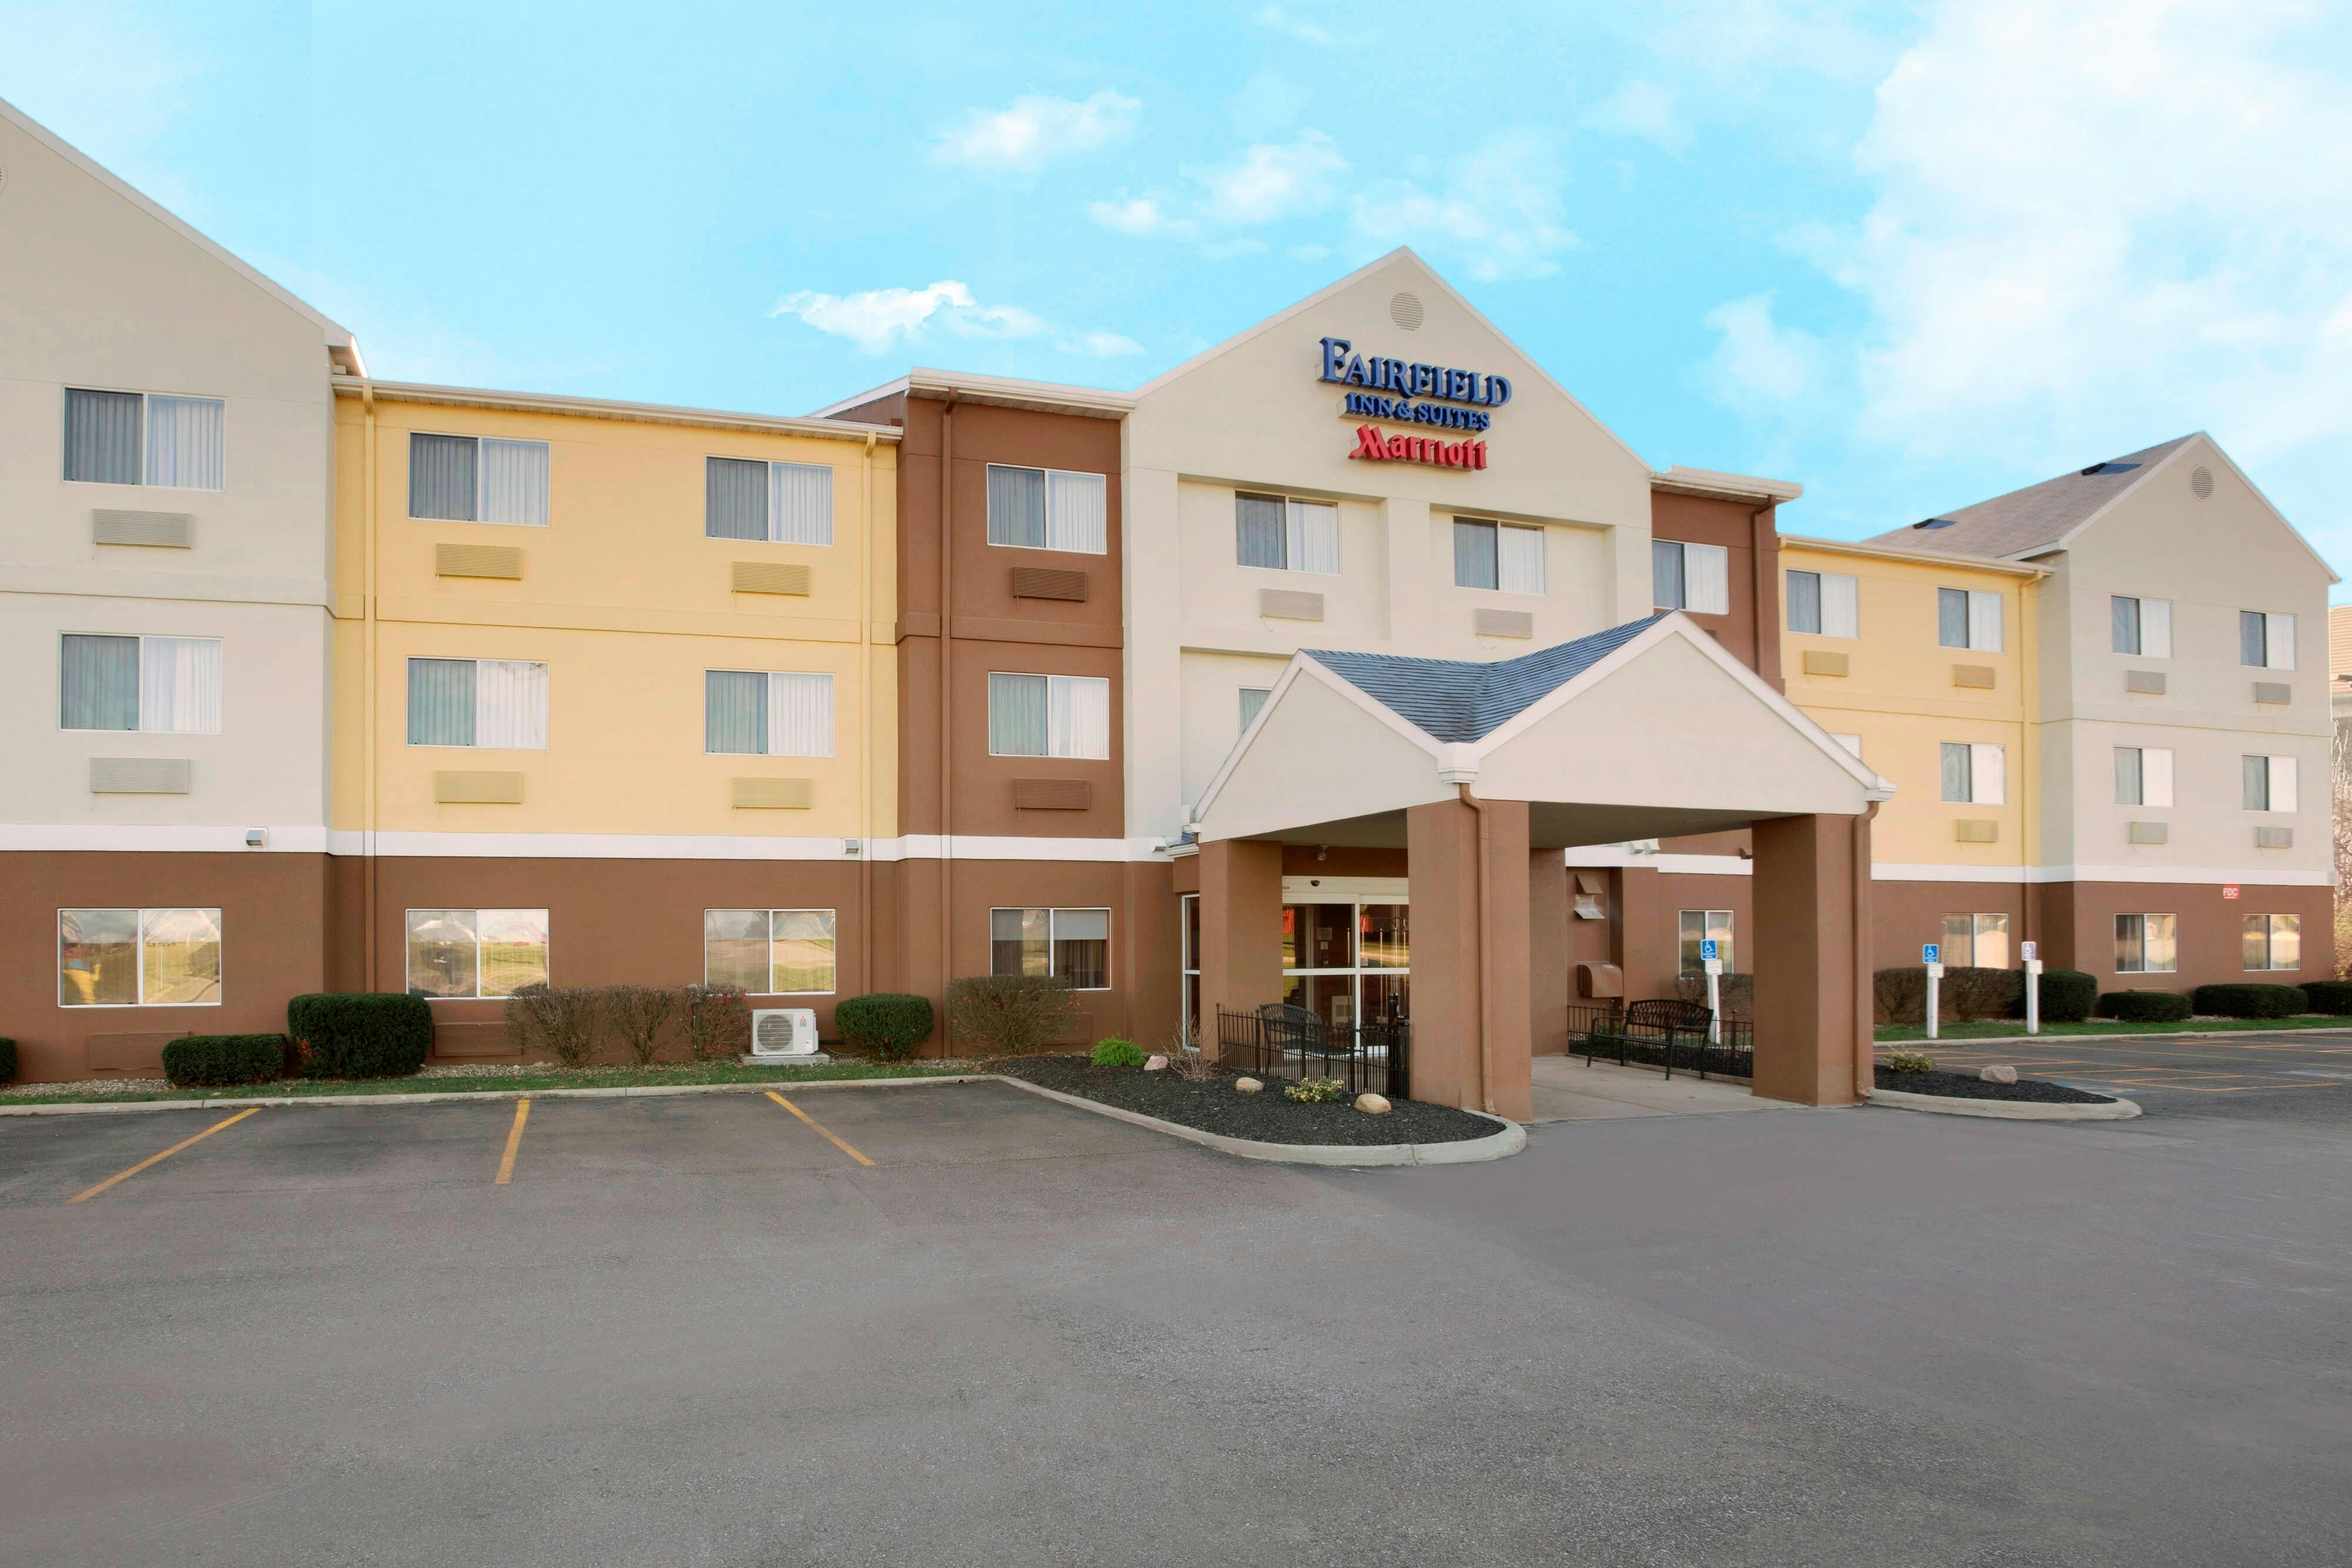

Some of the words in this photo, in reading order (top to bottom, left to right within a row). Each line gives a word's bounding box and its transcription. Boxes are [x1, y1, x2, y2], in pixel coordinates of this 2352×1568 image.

[1318, 336, 1512, 407] FAIRFIELD
[1345, 392, 1394, 418] INN
[1394, 400, 1413, 421] &
[1412, 402, 1491, 432] SUITES
[1348, 423, 1487, 470] Marriott
[2223, 888, 2238, 896] FDC
